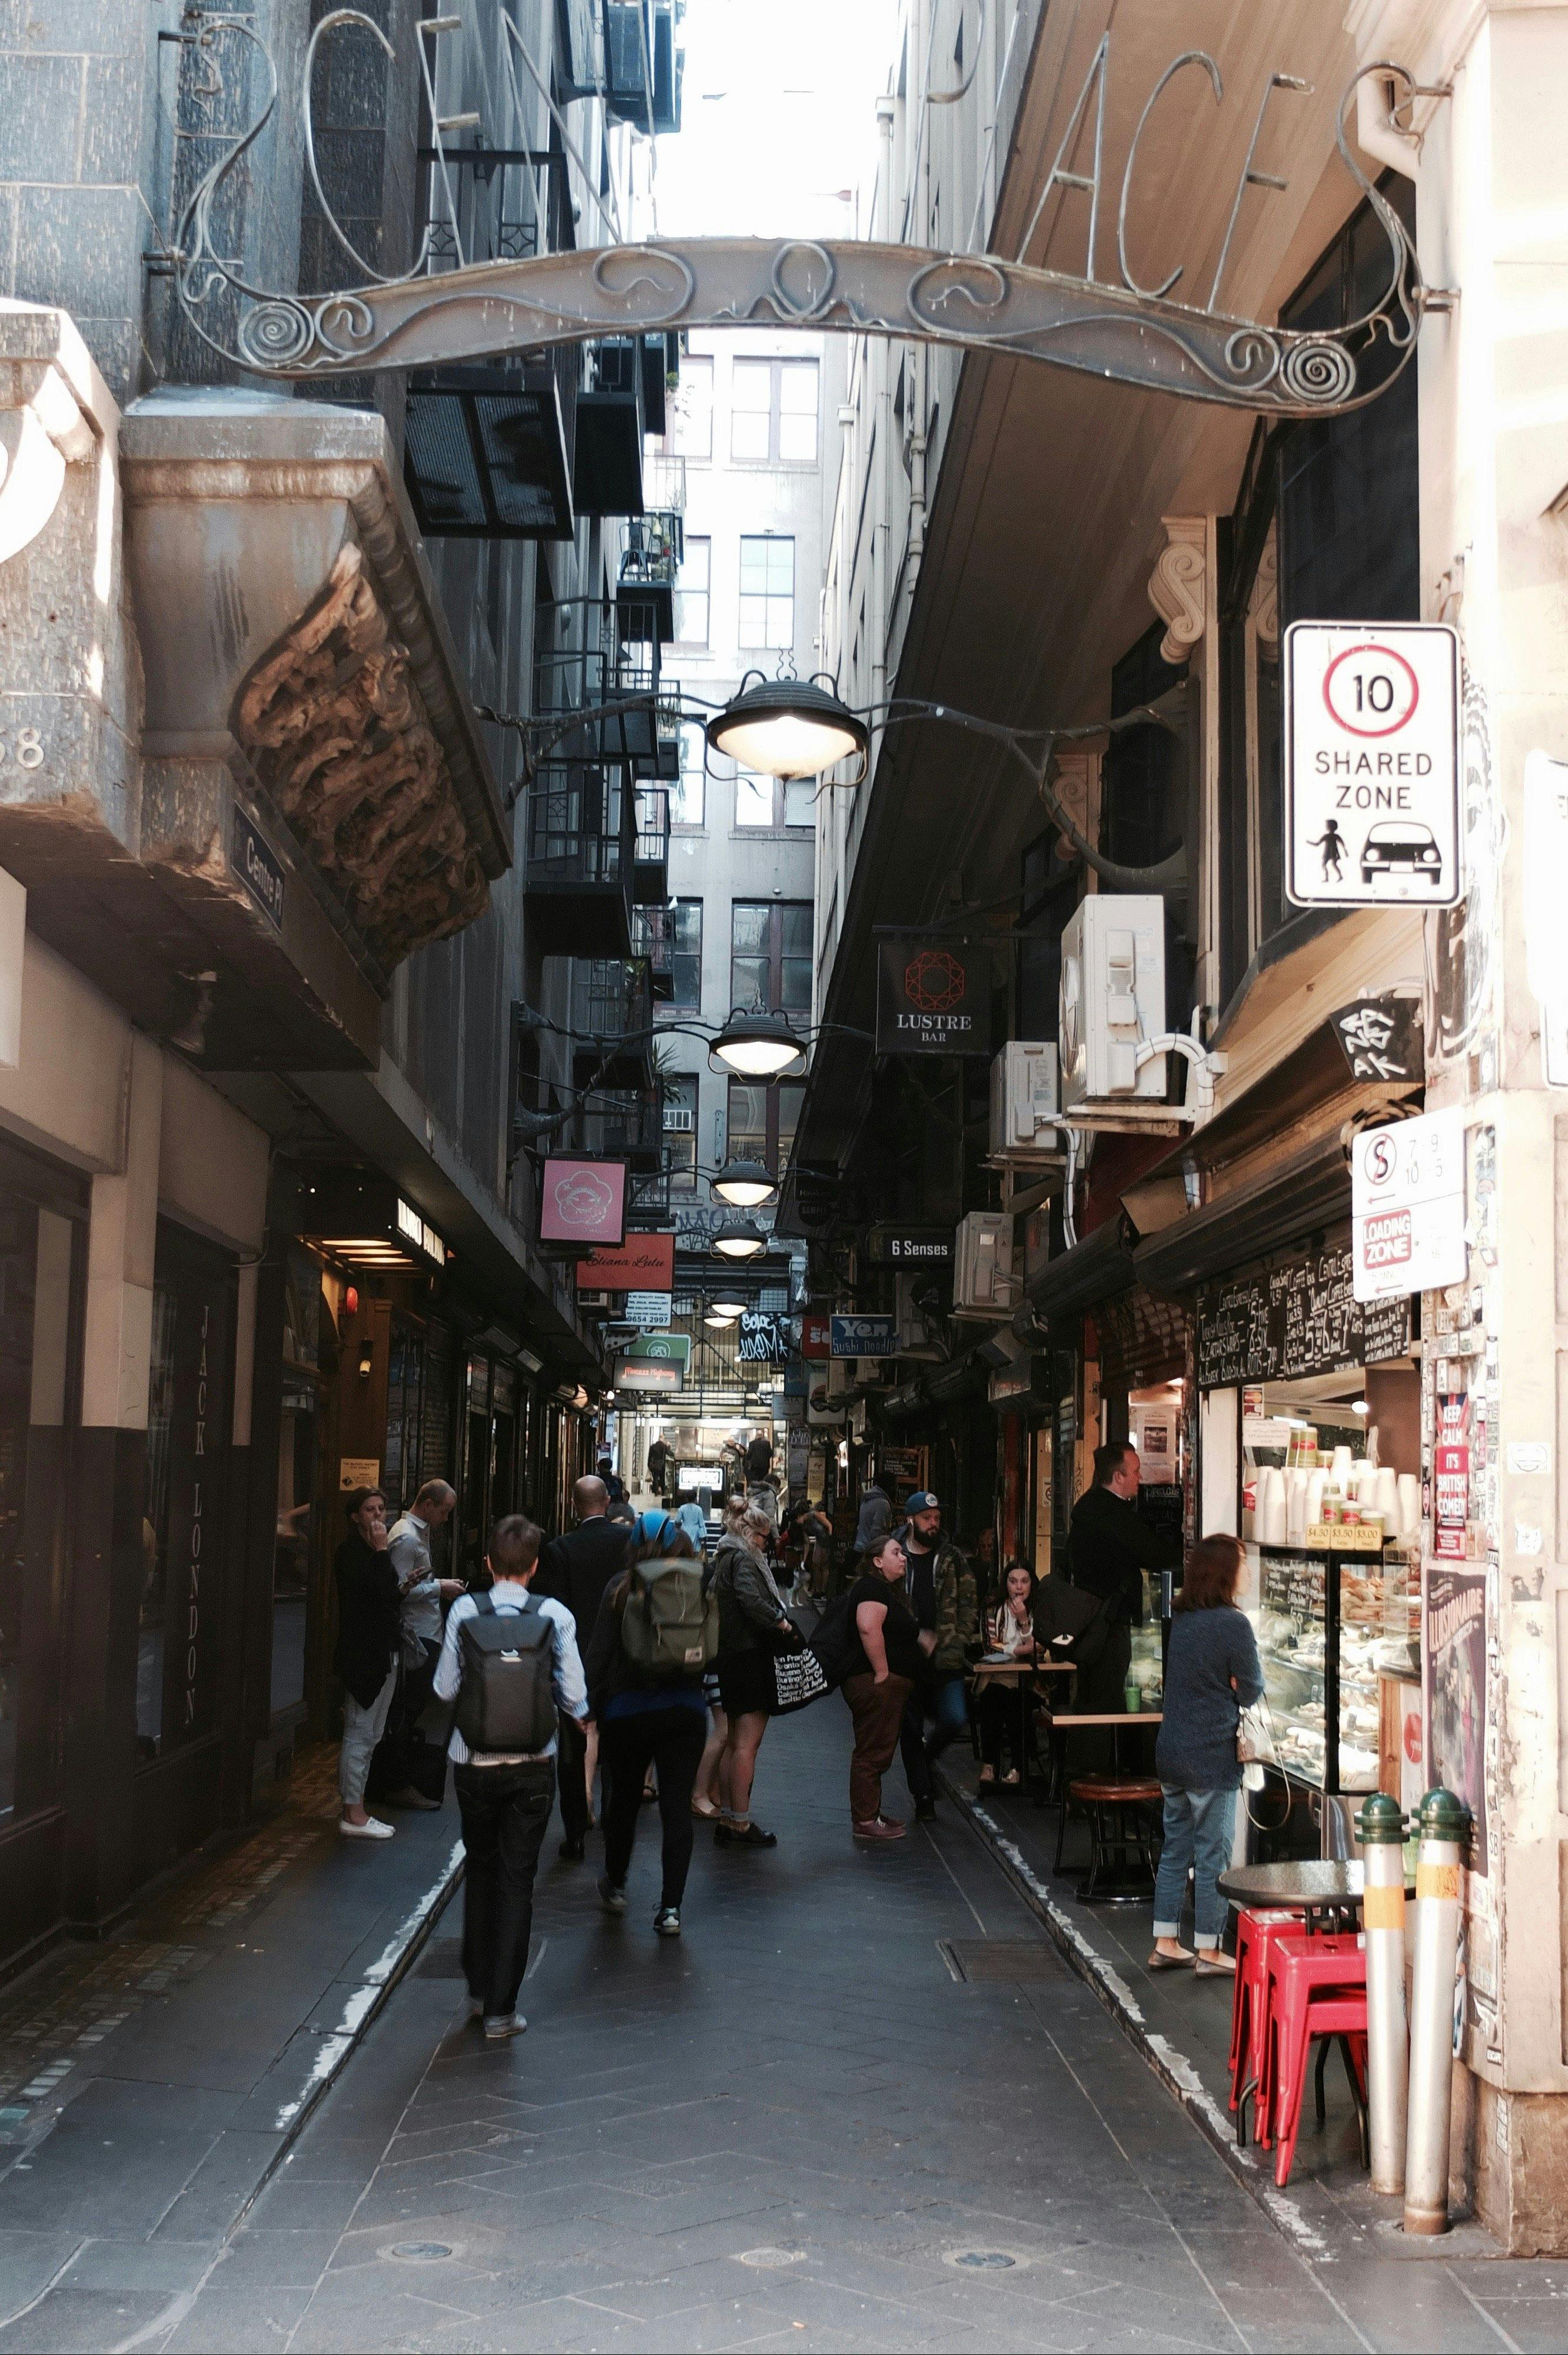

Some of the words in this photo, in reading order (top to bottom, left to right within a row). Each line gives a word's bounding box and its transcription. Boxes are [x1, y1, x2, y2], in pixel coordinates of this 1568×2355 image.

[1352, 675, 1395, 713] 10
[0, 728, 44, 769] 8
[1314, 750, 1433, 778] SHARED
[1336, 785, 1412, 810] ZONE
[897, 1014, 972, 1030] LUSTRE
[922, 1032, 946, 1042] BAR
[1364, 1214, 1411, 1244] LOADING
[892, 1240, 901, 1255] 6
[904, 1240, 948, 1256] Senses
[1366, 1236, 1409, 1264] ZONE
[838, 1320, 888, 1337] Yen
[195, 1306, 209, 1456] JACK
[1443, 1404, 1461, 1424] KEEP
[1442, 1428, 1463, 1446] CALM
[185, 1483, 202, 1724] LONDON
